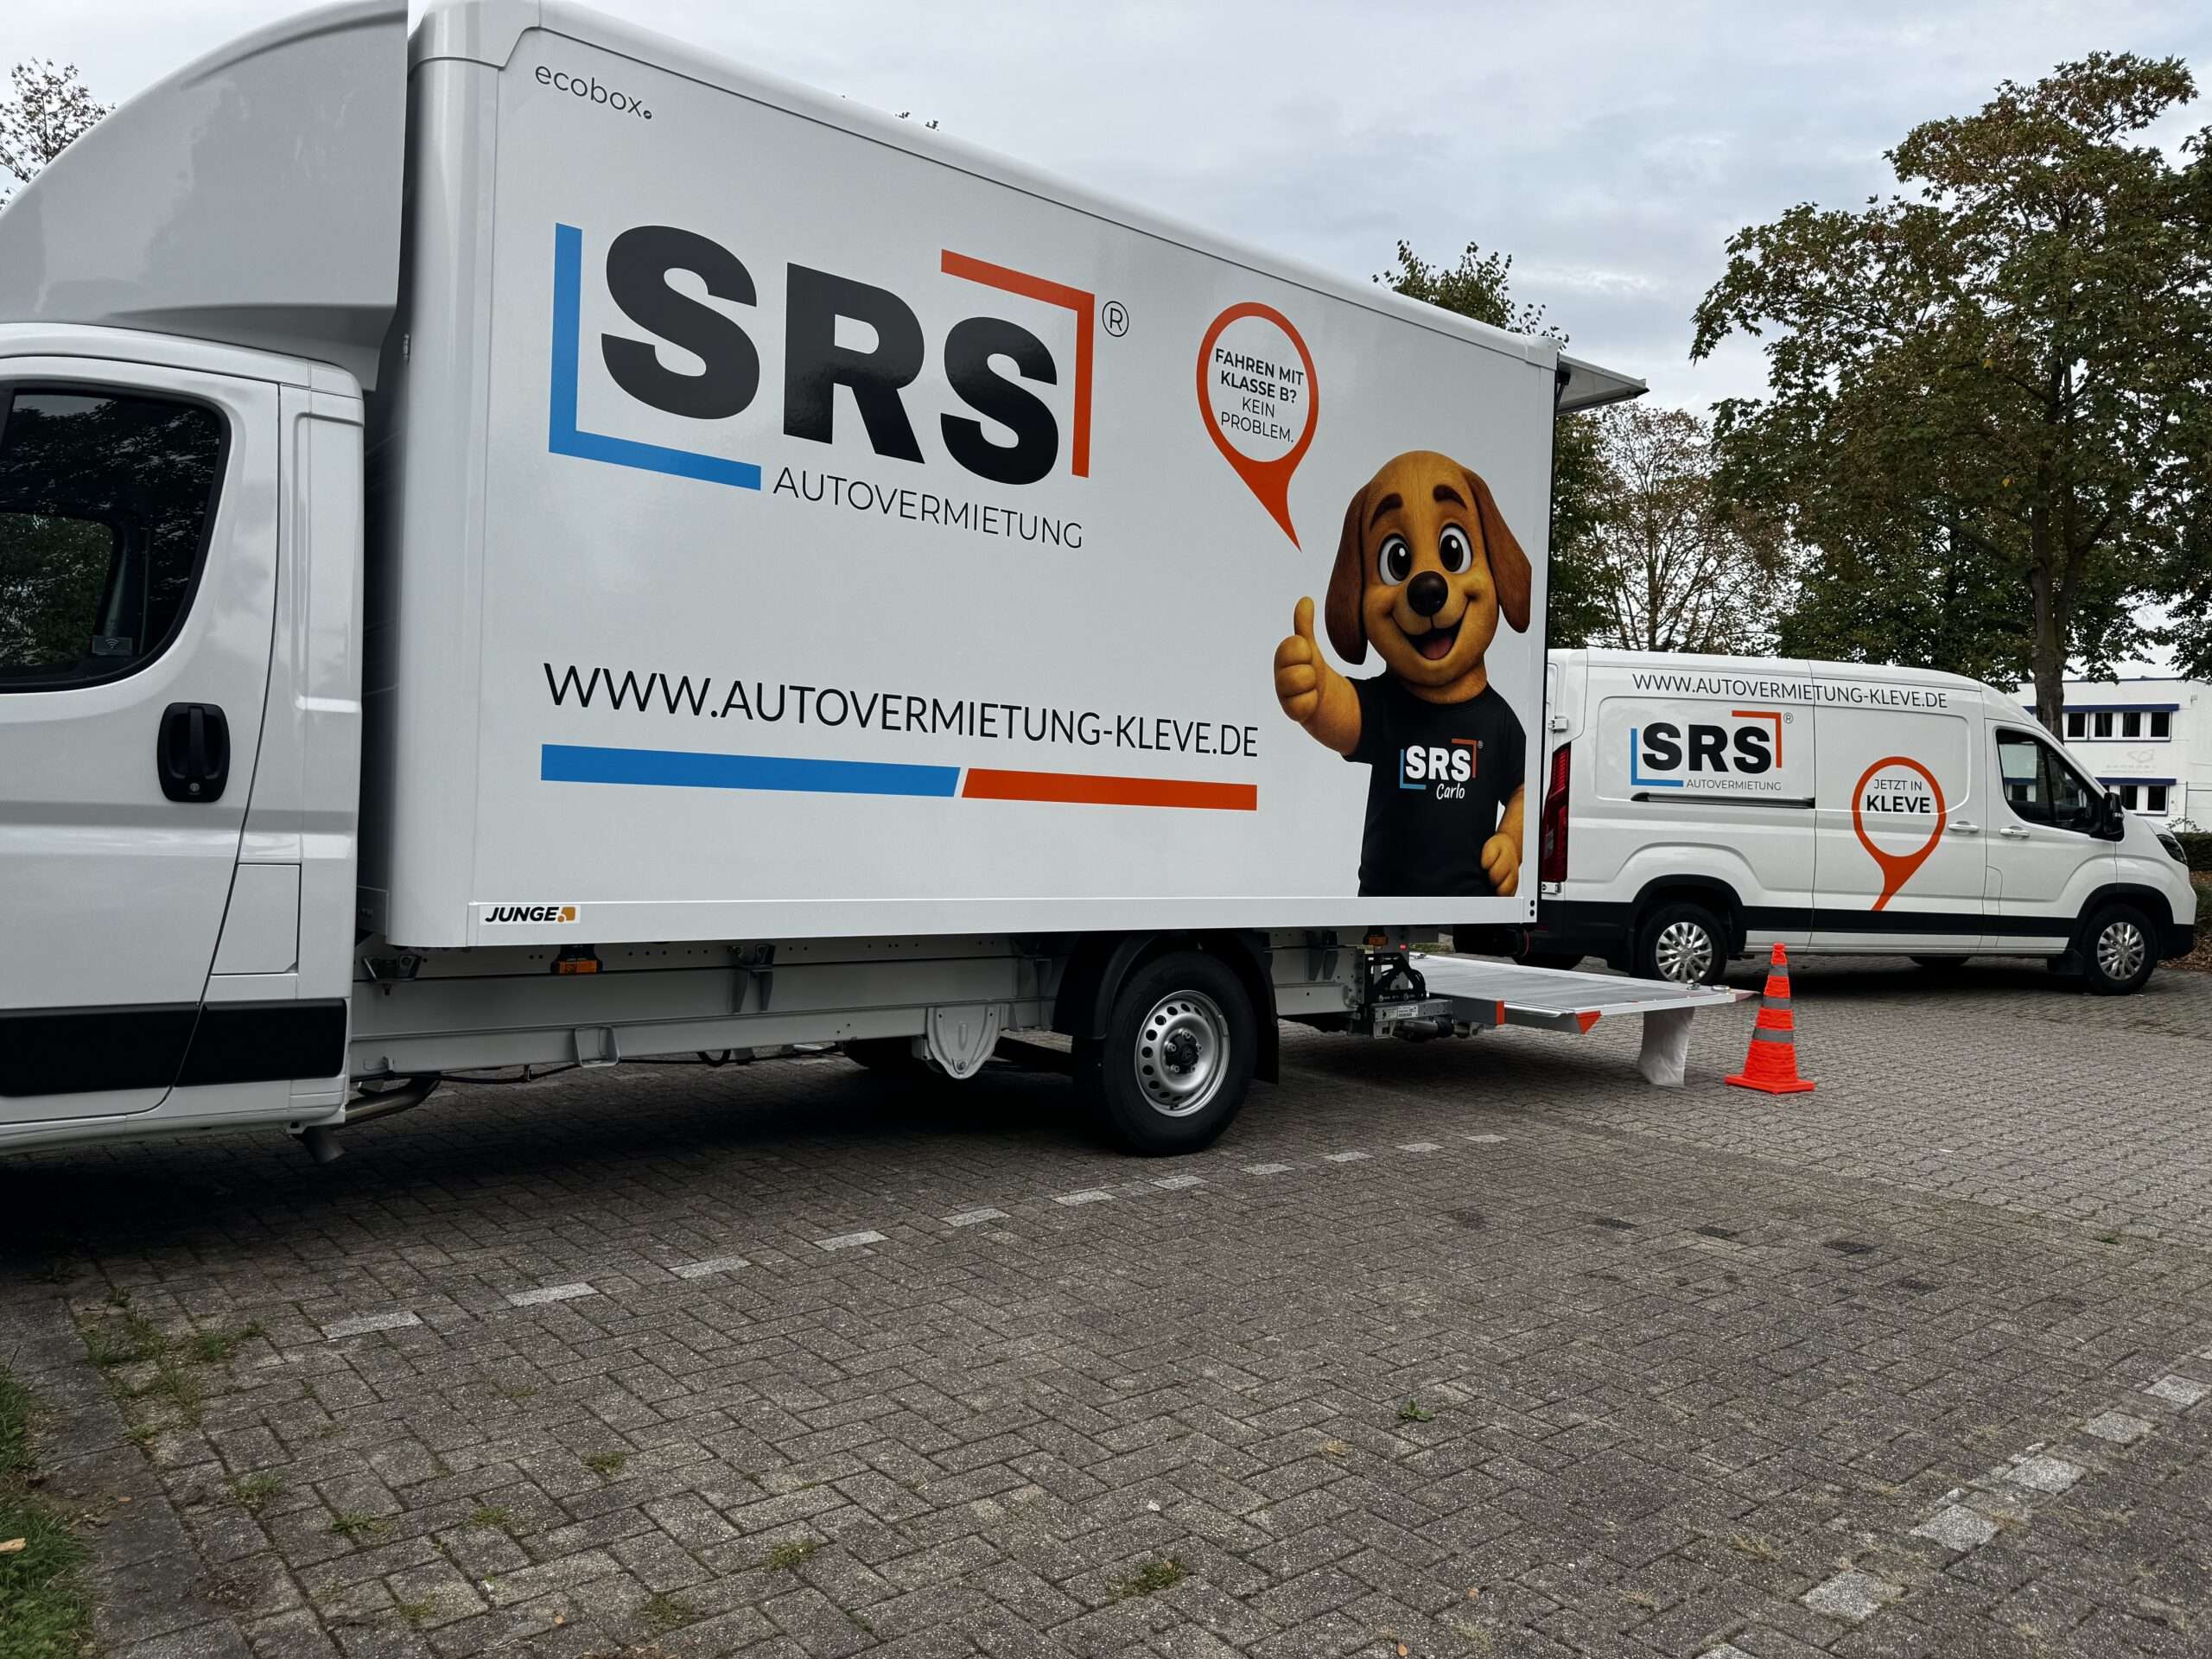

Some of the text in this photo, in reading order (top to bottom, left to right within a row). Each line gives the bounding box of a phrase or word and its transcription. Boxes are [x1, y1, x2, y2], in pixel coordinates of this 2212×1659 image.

[601, 225, 1058, 486] SRS
[1215, 347, 1304, 385] FAHREN MIT
[1221, 370, 1297, 404] KLASSE B?
[1242, 397, 1274, 418] KEIN
[1221, 411, 1294, 443] PROBLEM.
[773, 467, 1083, 549] AUTOVERMIETUNG
[1632, 673, 1948, 709] WWW.AUTOVERMIETUNG-KLEVE.DE
[543, 663, 1258, 758] WWW.AUTOVERMIETUNG-KLEVE.DE
[1405, 745, 1471, 782] SRS
[1643, 721, 1771, 774] SRS
[1436, 783, 1465, 800] Carlo
[1686, 779, 1782, 791] AUTOVERMIETUNG
[1873, 779, 1923, 791] JETZT IN
[1866, 794, 1931, 814] KLEVE
